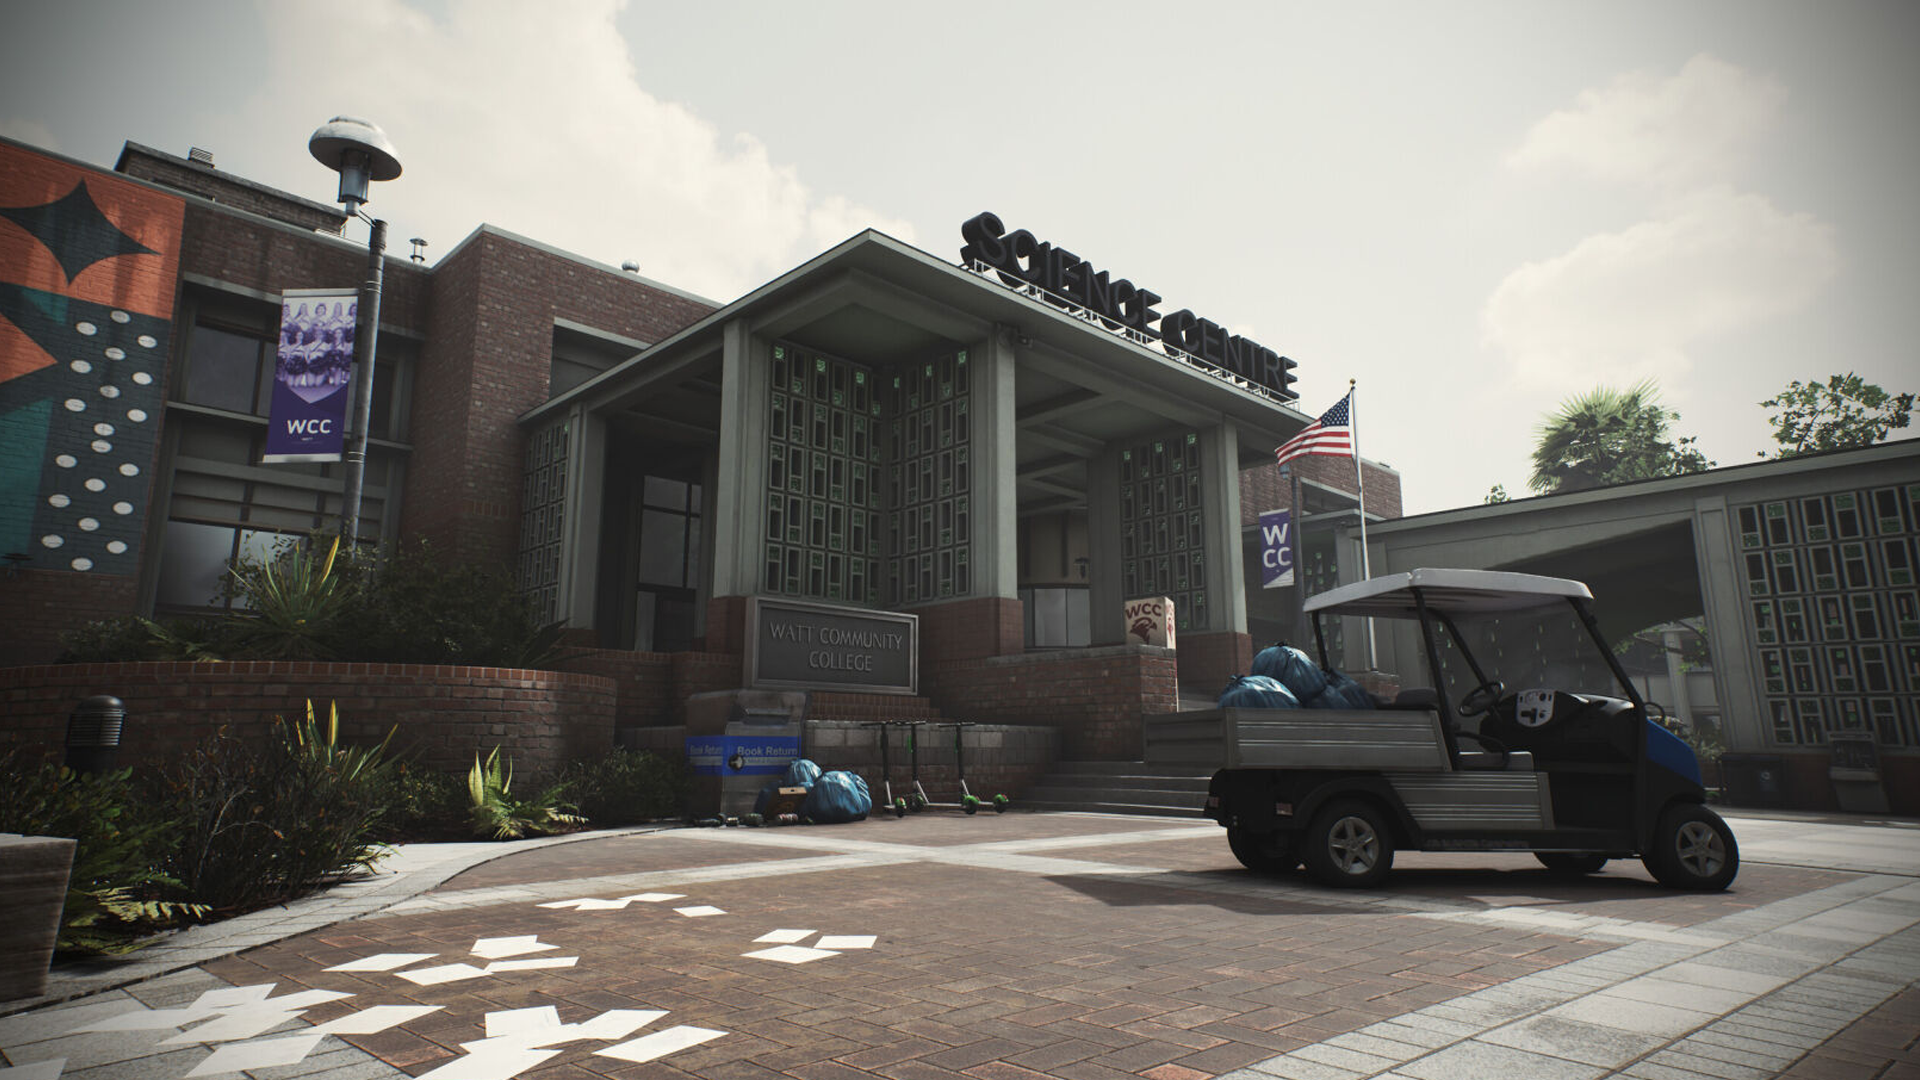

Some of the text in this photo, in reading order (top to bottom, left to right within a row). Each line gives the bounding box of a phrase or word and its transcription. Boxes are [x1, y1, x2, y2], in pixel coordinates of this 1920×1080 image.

[960, 211, 1300, 399] SCIENCE CENTRE
[287, 419, 332, 434] WCC
[1263, 523, 1288, 546] W
[1263, 546, 1292, 568] CC
[1126, 603, 1162, 620] WCC
[769, 621, 902, 649] WATT COMMUNITY
[809, 651, 872, 671] COLLEGE
[737, 746, 798, 756] Book Return
